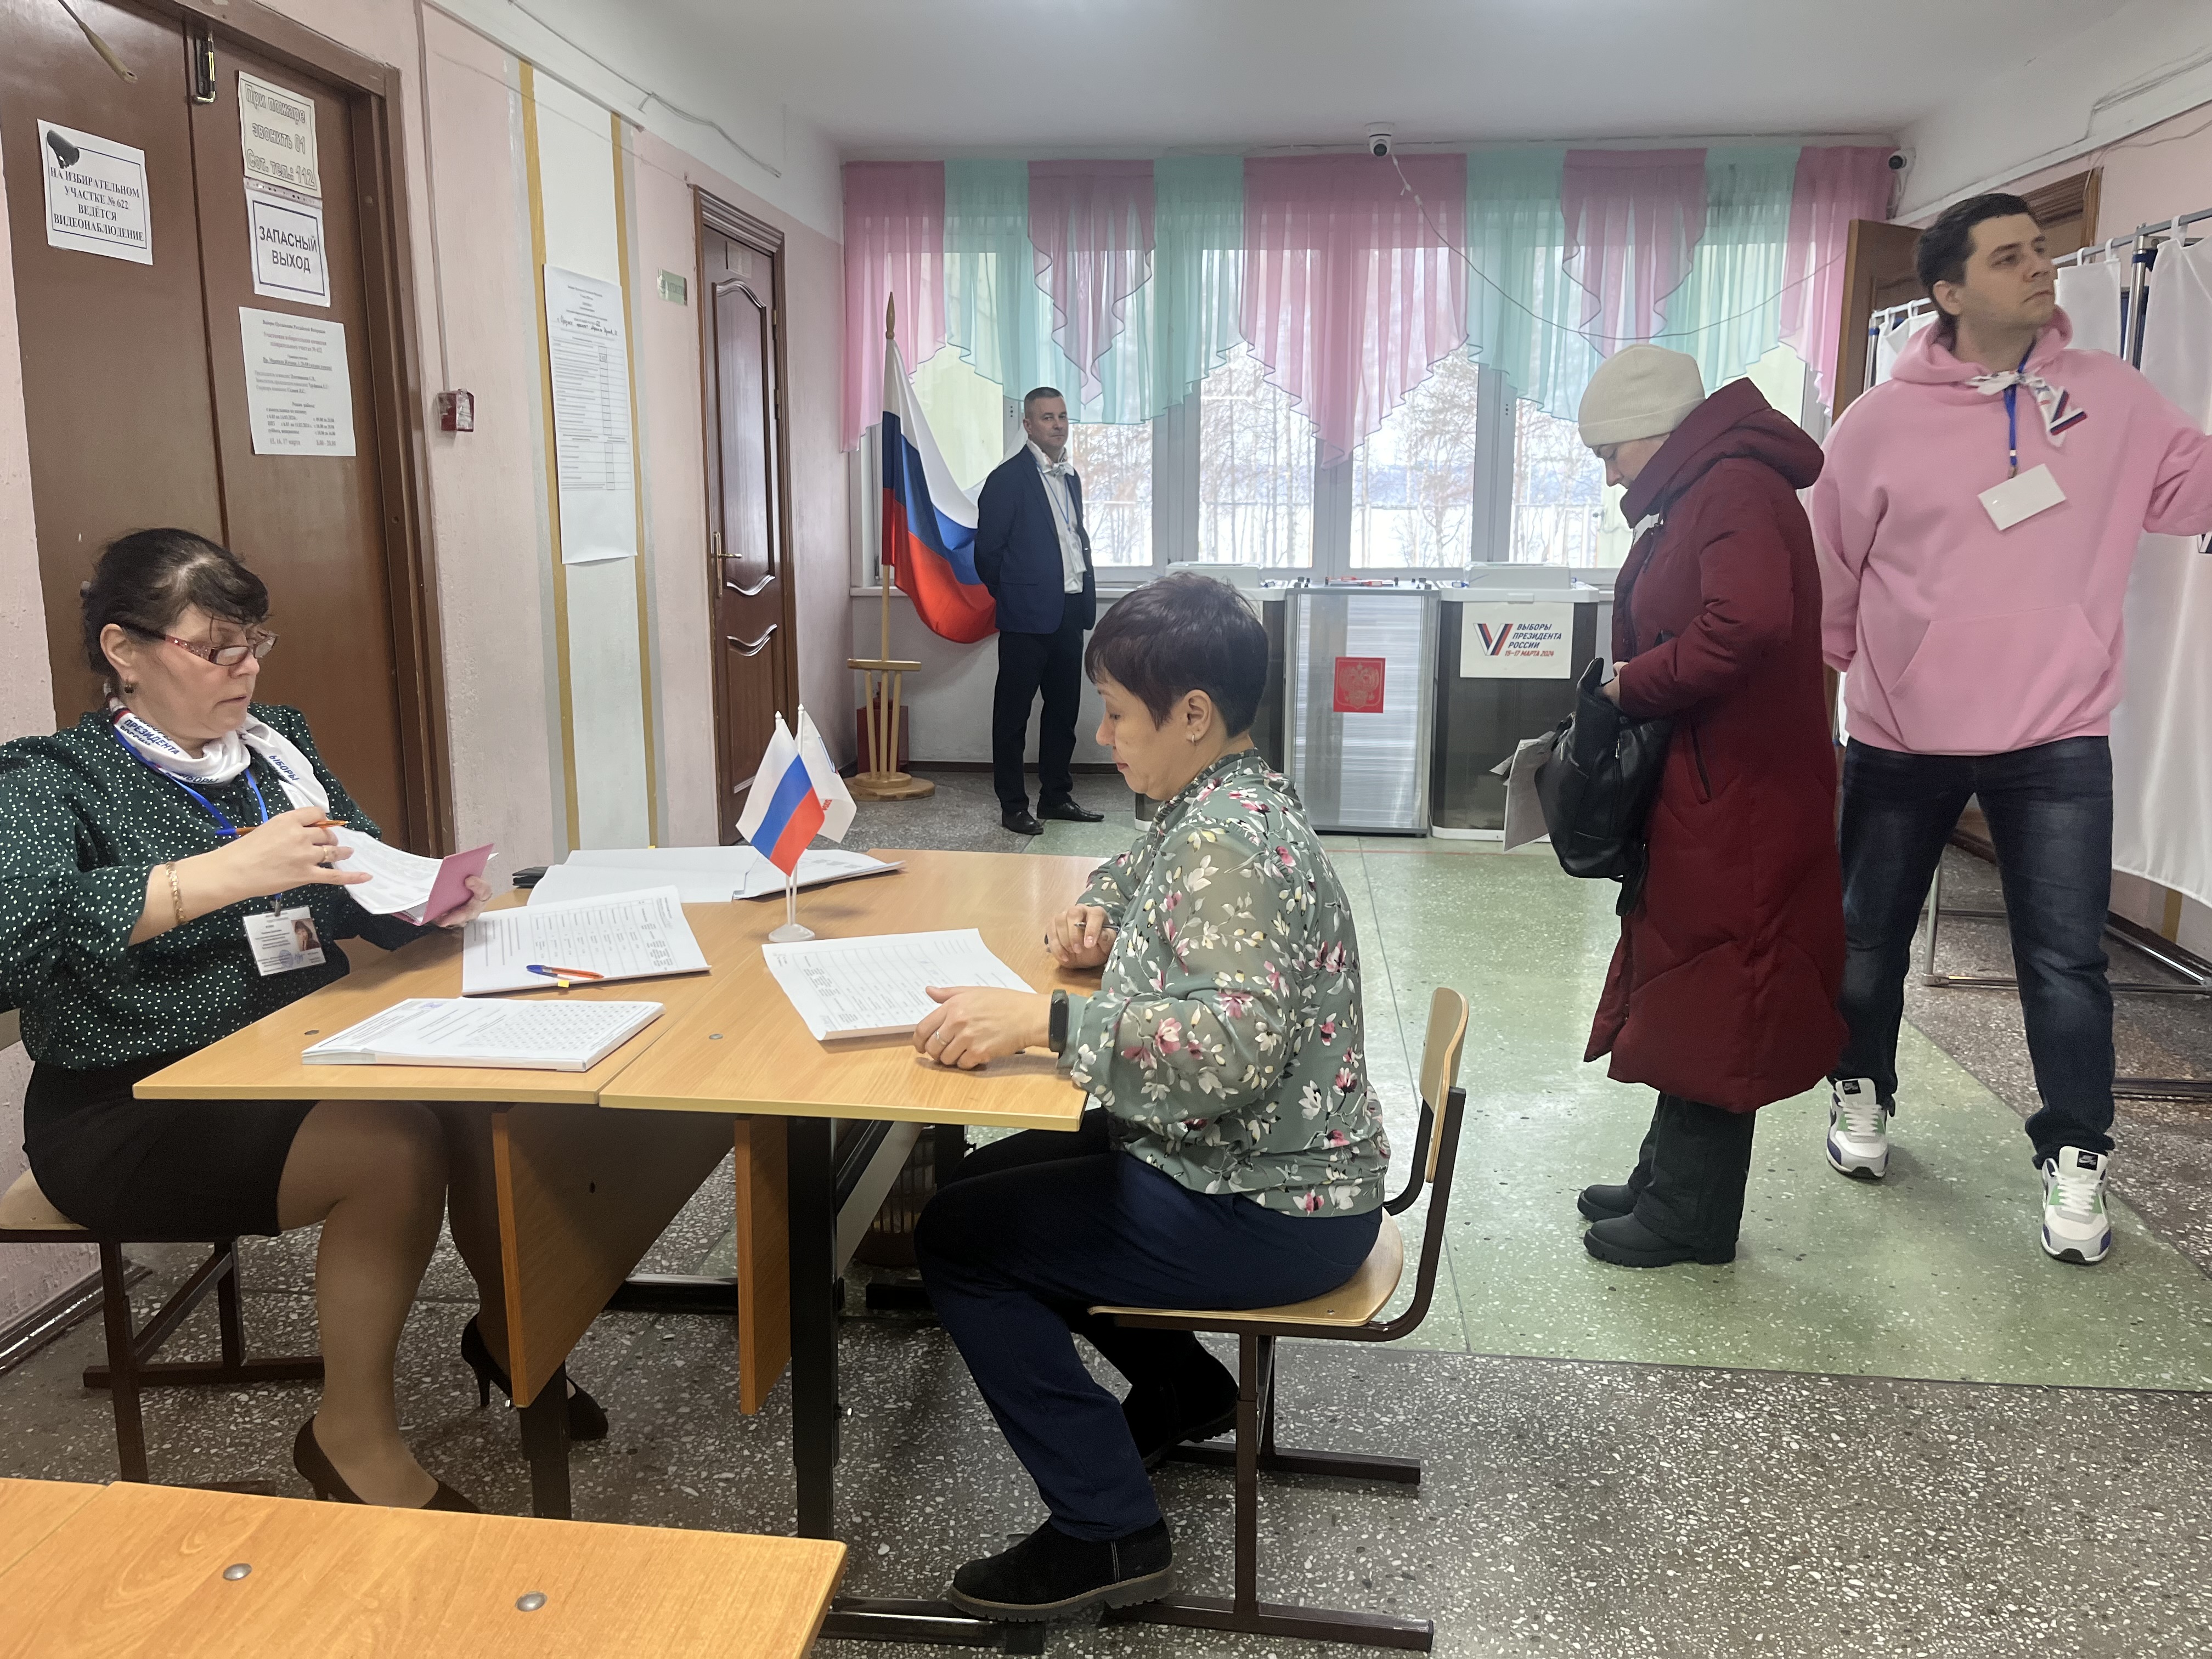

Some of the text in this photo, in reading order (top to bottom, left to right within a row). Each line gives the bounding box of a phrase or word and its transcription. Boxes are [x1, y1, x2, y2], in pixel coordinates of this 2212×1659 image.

[245, 83, 306, 125] При пожаре
[252, 122, 305, 154] звонить 01
[50, 167, 140, 198] НА ИЗБИРАТЕЛЬНОМ
[247, 149, 269, 172] Сот.
[296, 165, 315, 187] 112
[64, 185, 106, 205] УЧАСТКЕ
[117, 198, 129, 210] 622
[54, 213, 144, 241] ВИДЕОНАБЛЮДЕНИЕ
[78, 204, 117, 221] ВЕДЁТСЯ
[259, 225, 318, 253] ЗАПАСНЫЙ
[272, 249, 311, 274] ВЫХОД
[123, 719, 180, 754] ПРЕЗИДЕНТА
